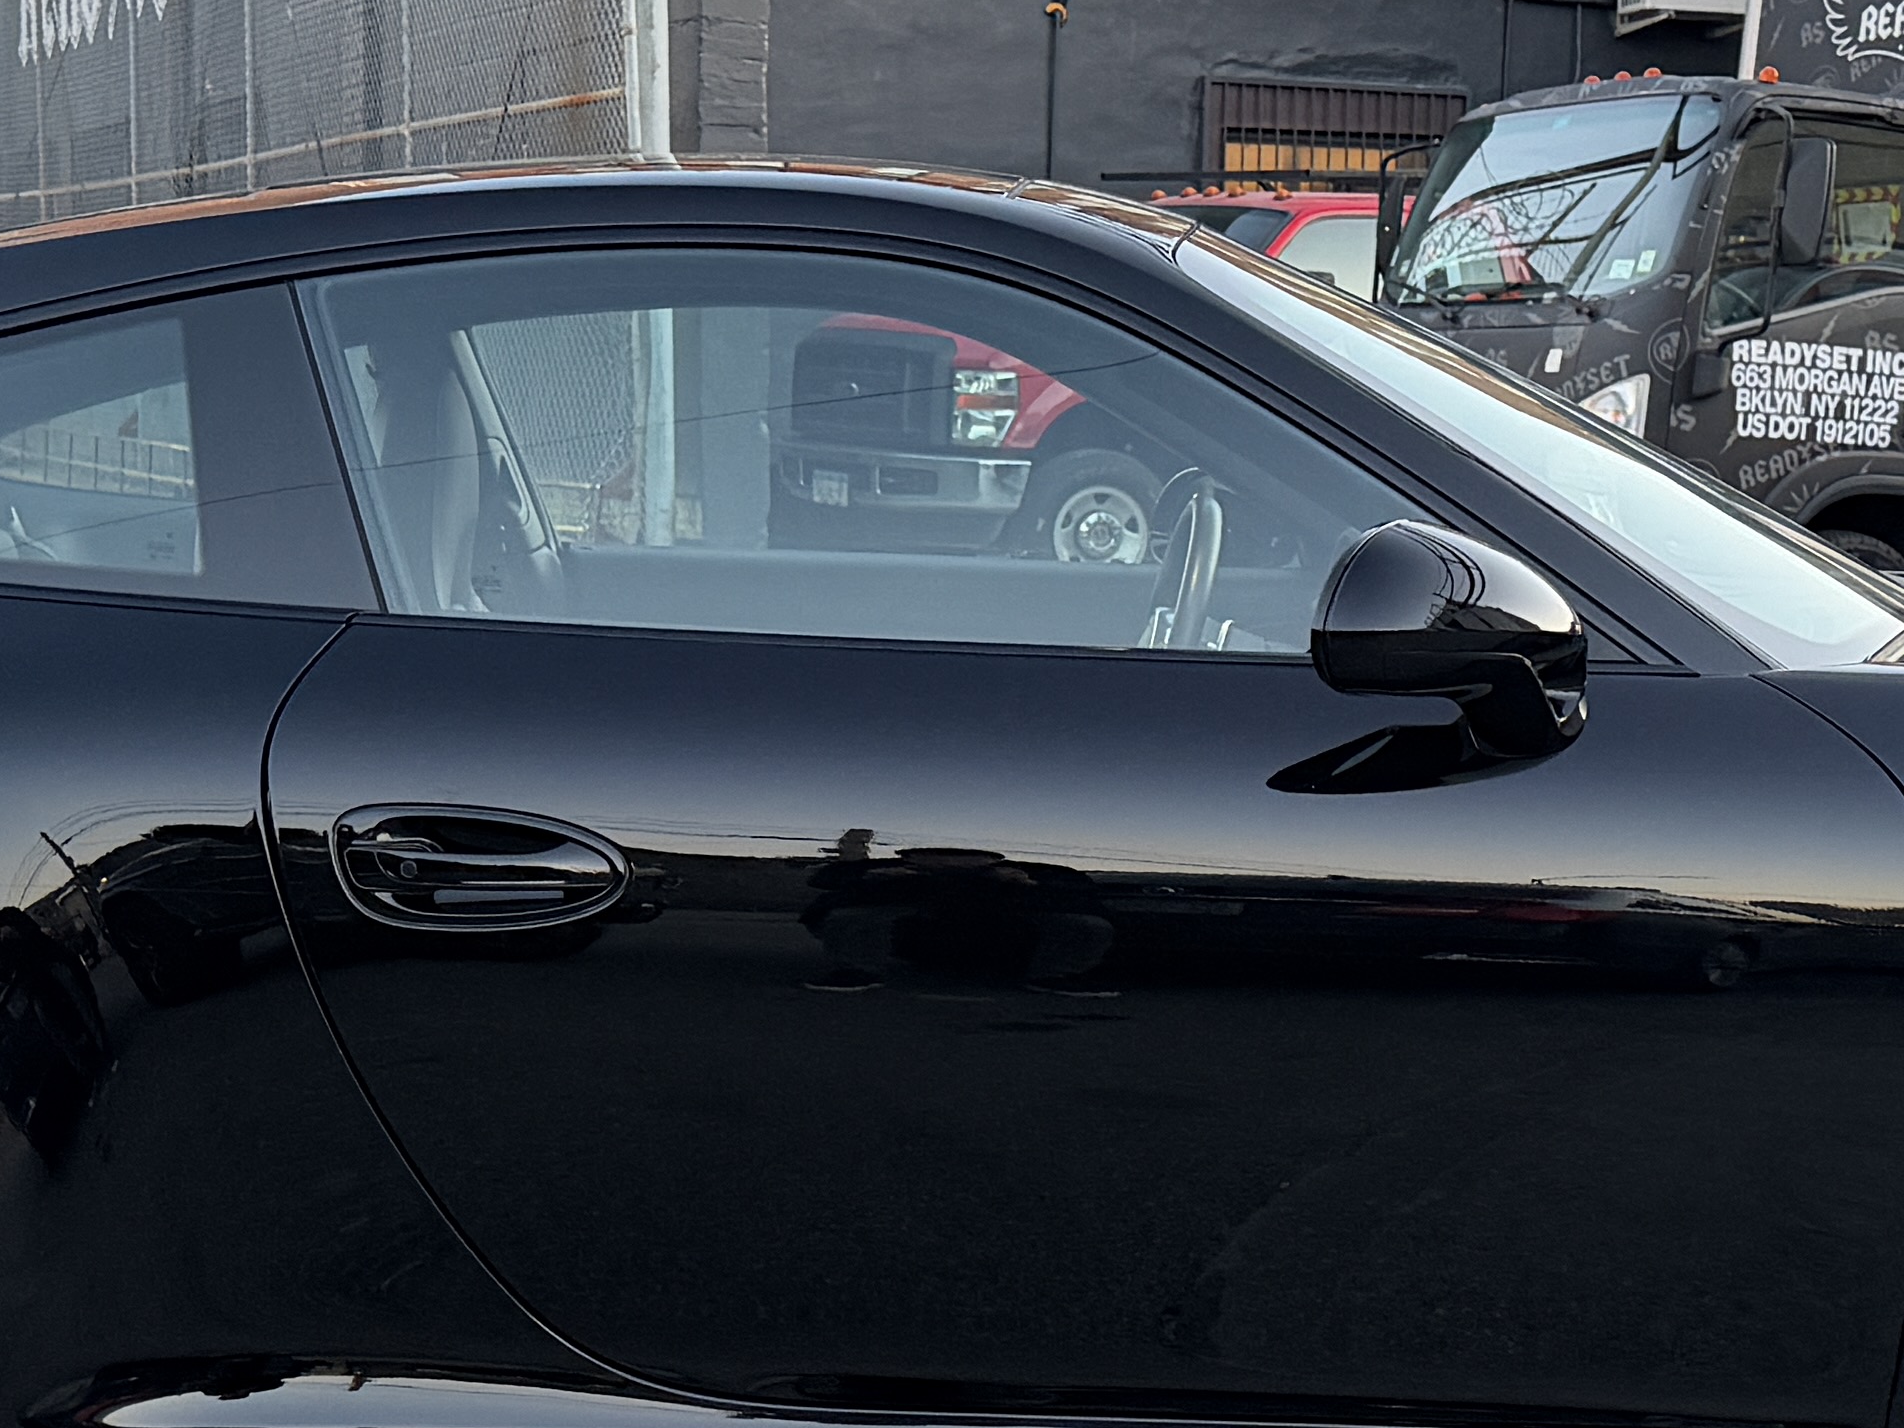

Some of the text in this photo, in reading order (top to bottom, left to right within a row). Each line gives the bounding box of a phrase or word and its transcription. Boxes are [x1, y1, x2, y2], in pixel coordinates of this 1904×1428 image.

[1732, 339, 1863, 371] READYSET
[1731, 363, 1772, 388] 663
[1775, 366, 1867, 397] MORGAN
[1810, 395, 1841, 419] NY
[1844, 398, 1900, 424] 11222
[1737, 413, 1892, 448] US DOT 1912105
